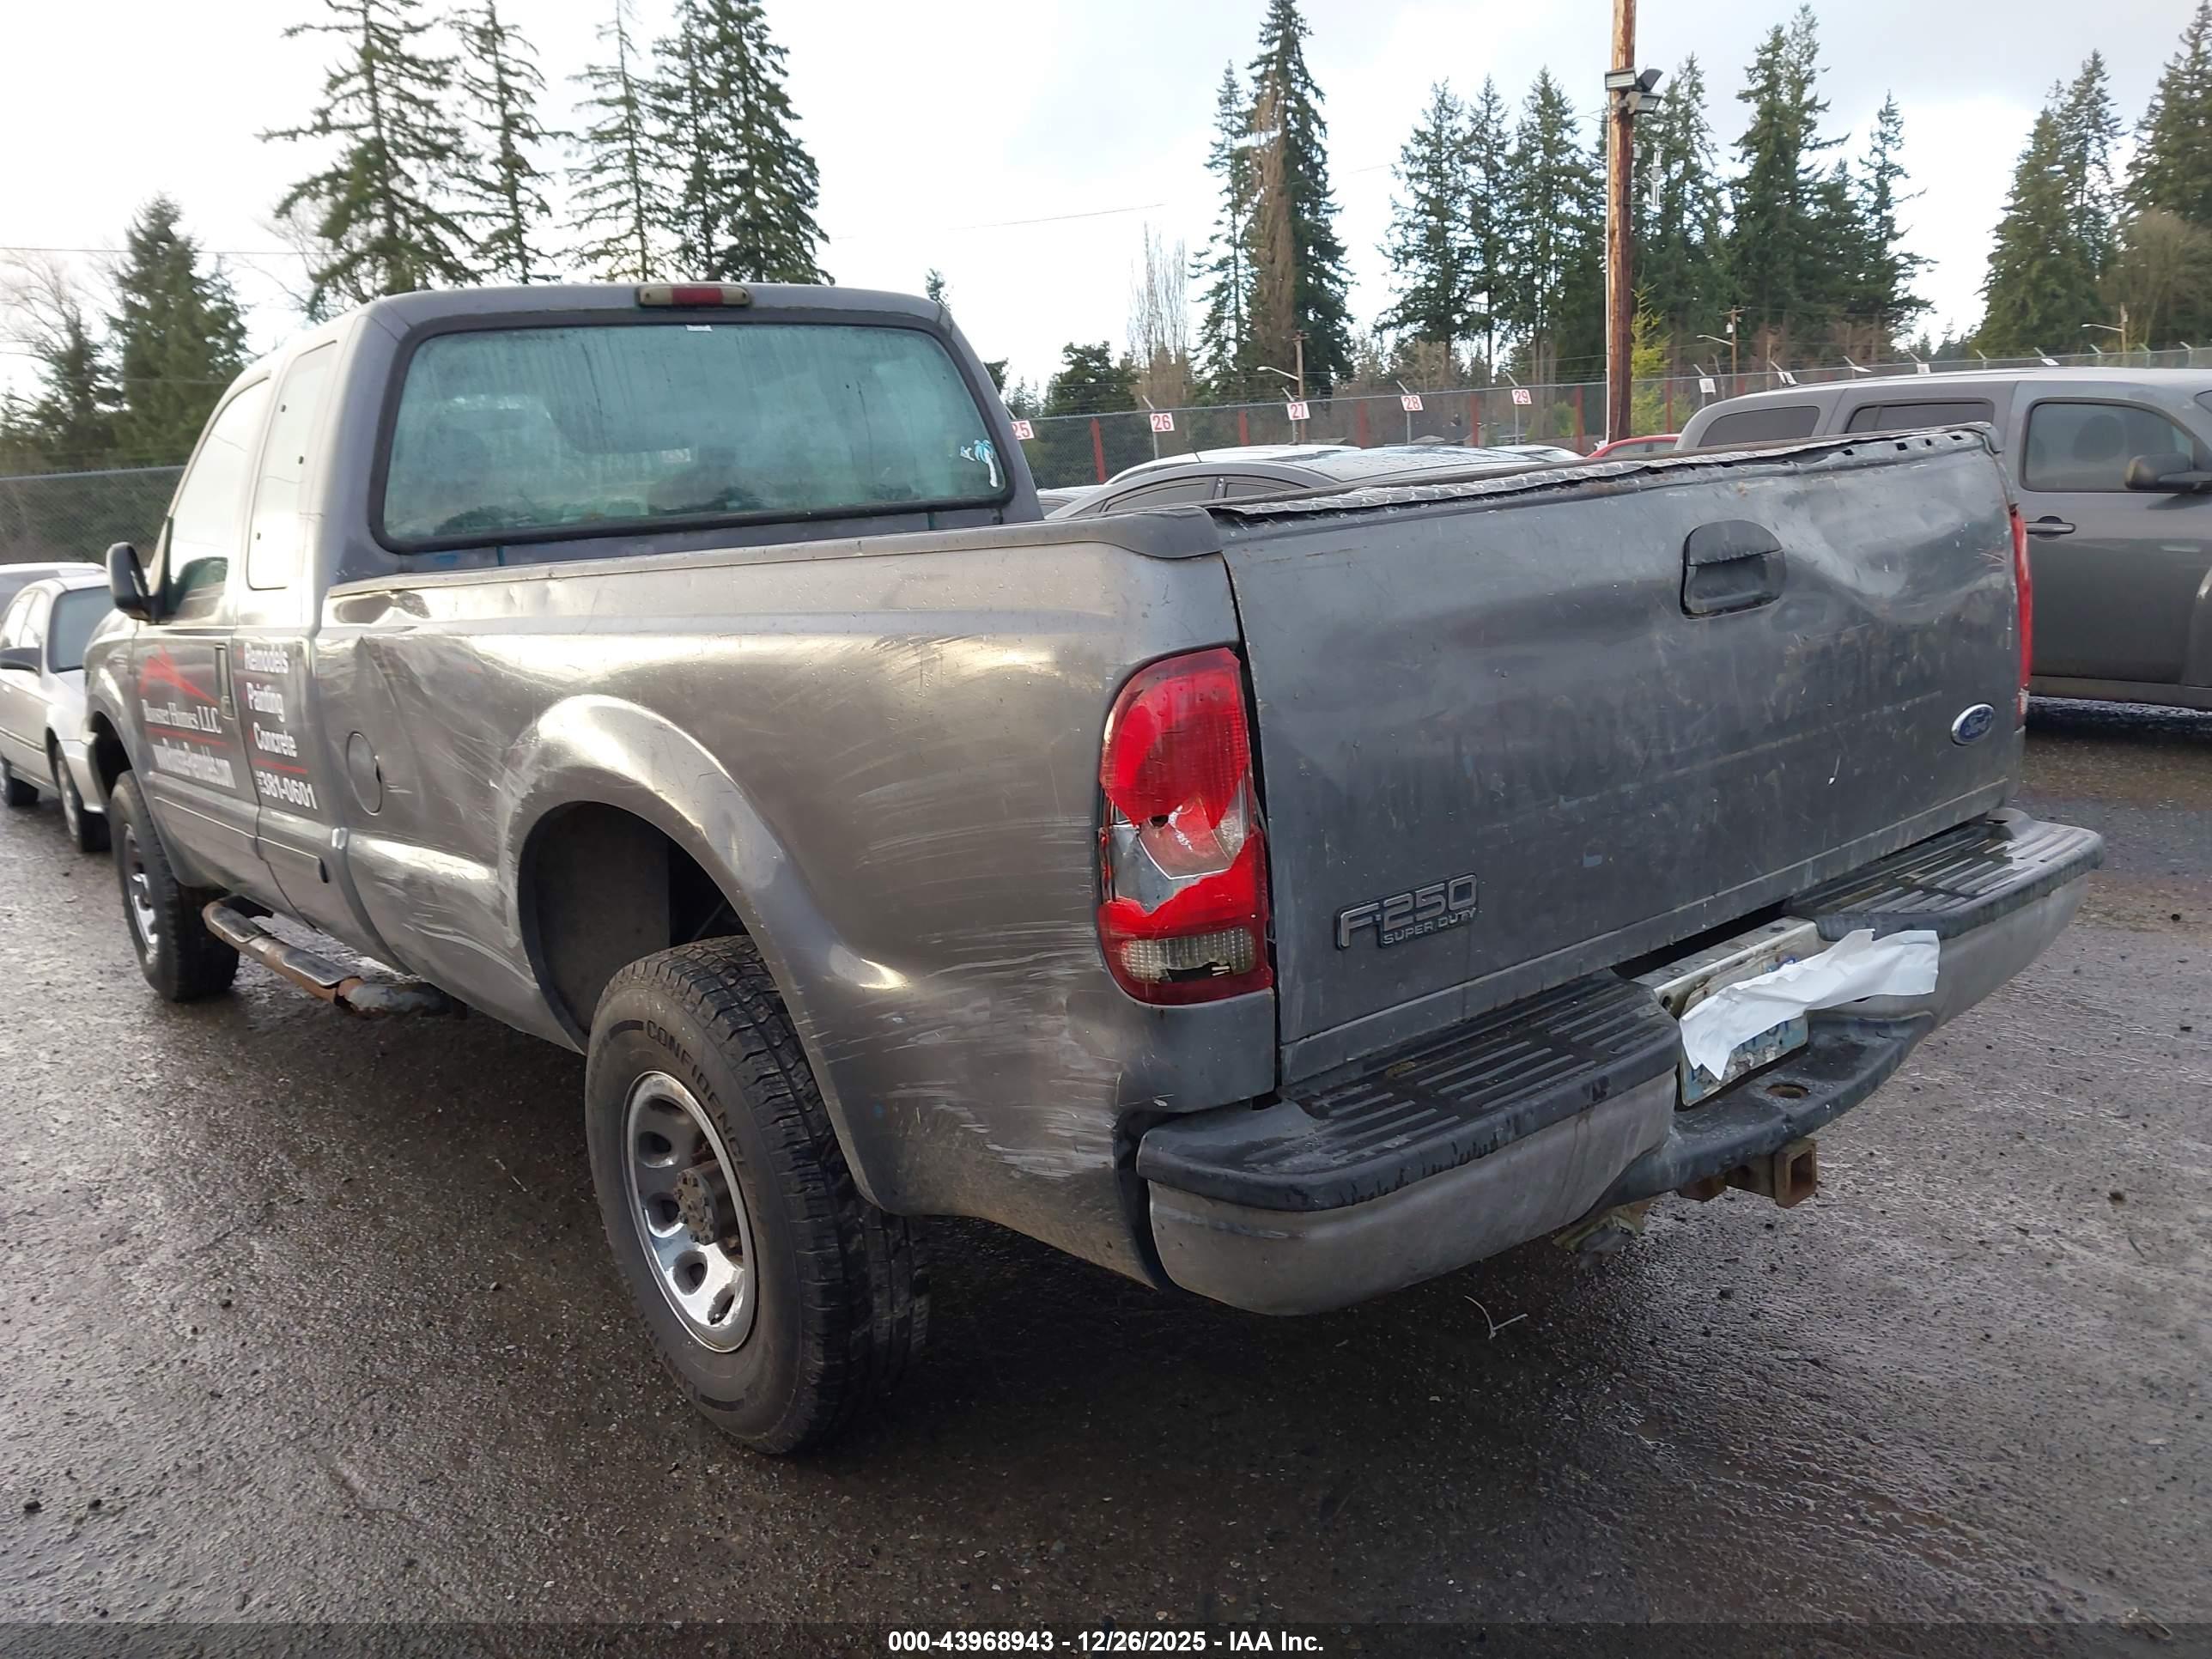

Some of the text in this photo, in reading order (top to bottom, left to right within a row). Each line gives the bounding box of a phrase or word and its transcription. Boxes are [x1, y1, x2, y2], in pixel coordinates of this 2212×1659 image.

[1291, 404, 1304, 418] 27
[1404, 396, 1419, 410] 28
[1515, 390, 1529, 404] 29
[1152, 415, 1171, 430] 26
[245, 642, 289, 674] Remodels
[246, 682, 285, 722] Painting
[196, 705, 222, 734] LLC
[253, 722, 297, 757] Concrete
[1382, 907, 1477, 945] SUPER DUTY
